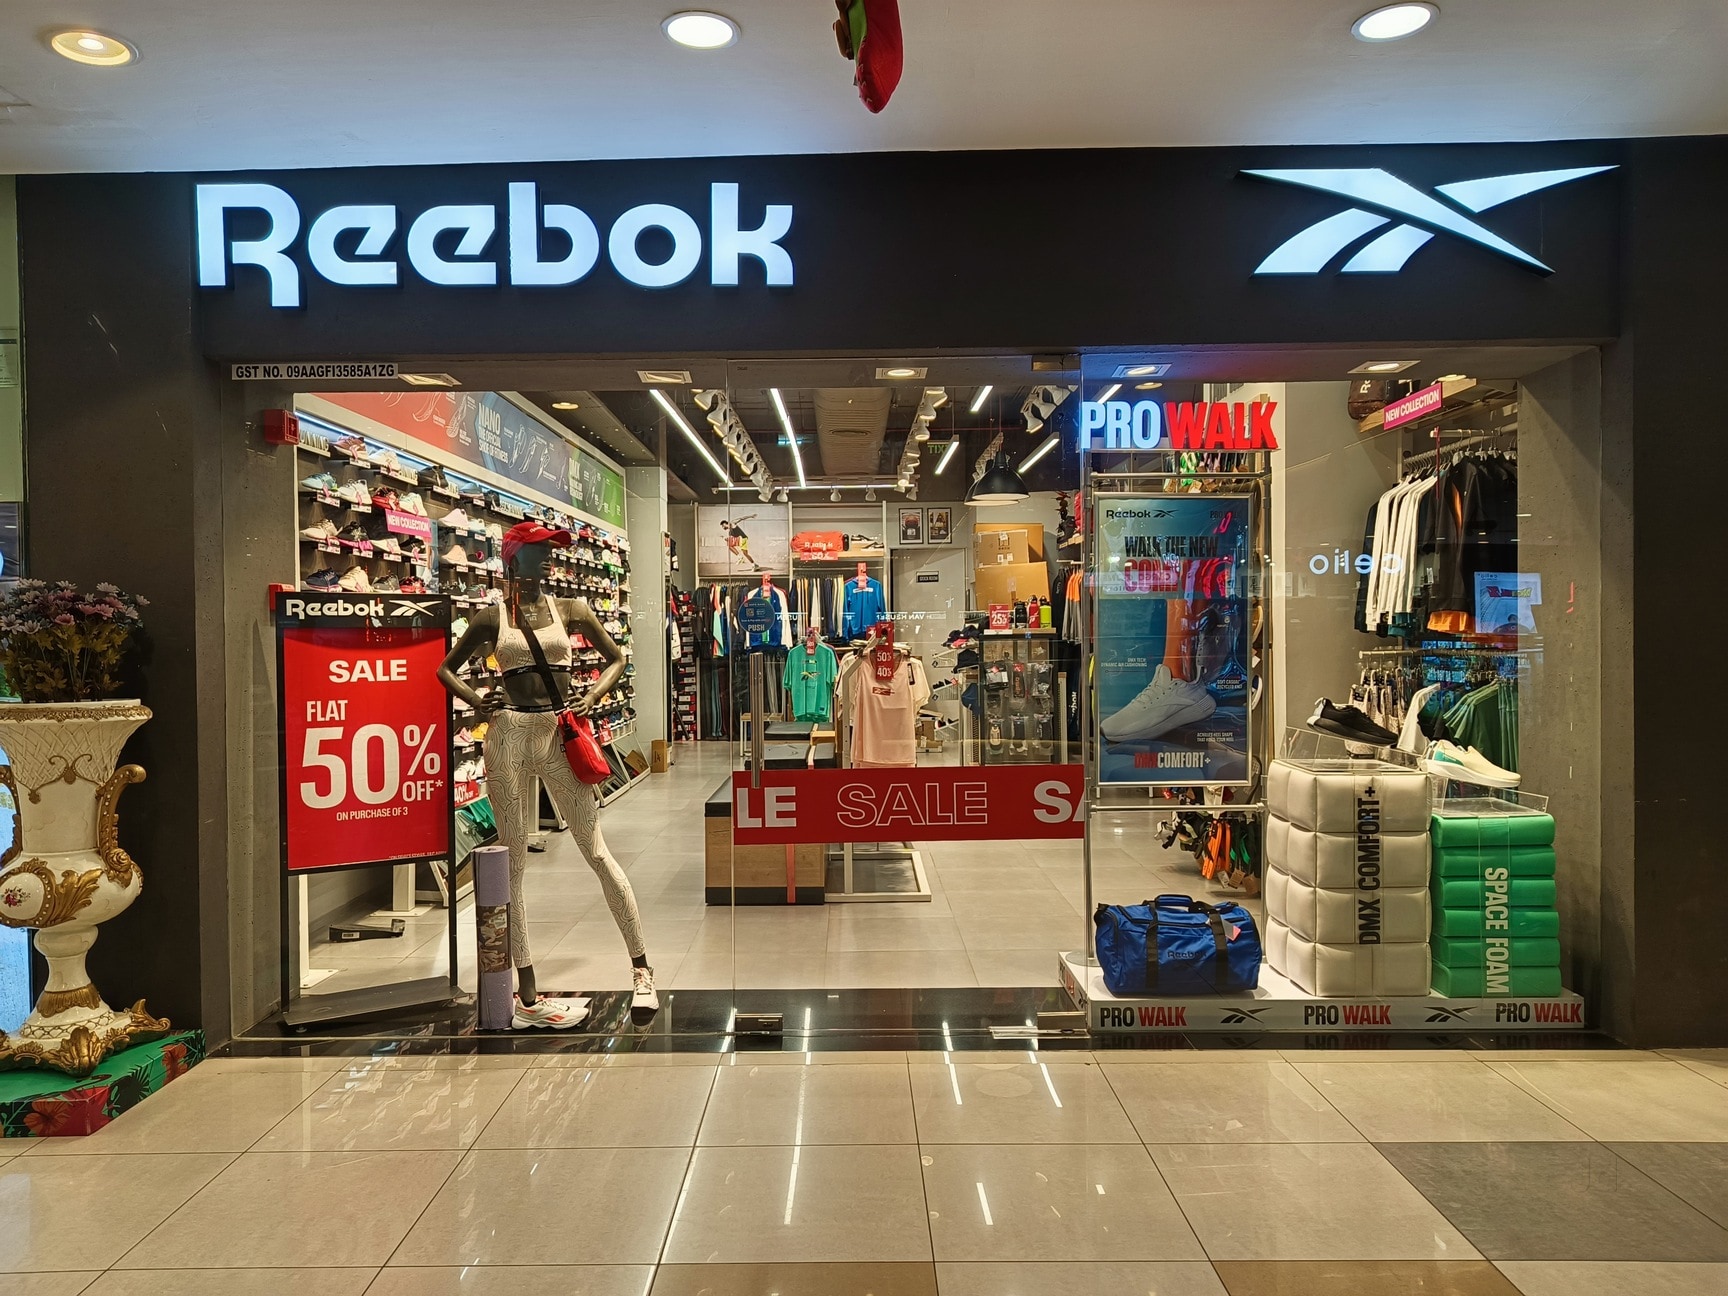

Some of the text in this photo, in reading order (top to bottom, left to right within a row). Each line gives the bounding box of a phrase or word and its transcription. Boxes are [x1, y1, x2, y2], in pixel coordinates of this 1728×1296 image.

[196, 182, 793, 308] Reebok
[236, 365, 394, 378] GST NO. 09AAGFI3585A1ZG
[1385, 389, 1440, 423] NEW COLLECTION
[479, 402, 501, 436] NANO
[1080, 399, 1279, 450] PRO WALK
[299, 430, 329, 451] UNNING
[388, 513, 430, 532] NEW COLLECTION
[1106, 509, 1151, 519] Reebok
[1124, 536, 1219, 557] WALK THE NEW
[285, 599, 385, 620] Reebok
[991, 613, 1008, 625] 25%
[748, 624, 765, 632] PUSH
[877, 651, 892, 662] 50%
[328, 659, 408, 683] SALE
[877, 667, 892, 677] 40%
[306, 700, 348, 722] FLAT
[301, 723, 441, 809] 50%
[336, 807, 408, 821] ON PURCHASE OF 3
[737, 780, 1084, 829] LE SALE S
[1358, 898, 1381, 944] DMX
[1485, 867, 1510, 993] SPACE FOAM
[1100, 1006, 1187, 1027] PRO WALK
[1304, 1004, 1391, 1025] PRO WALK
[1495, 1002, 1582, 1023] PRO WALK
